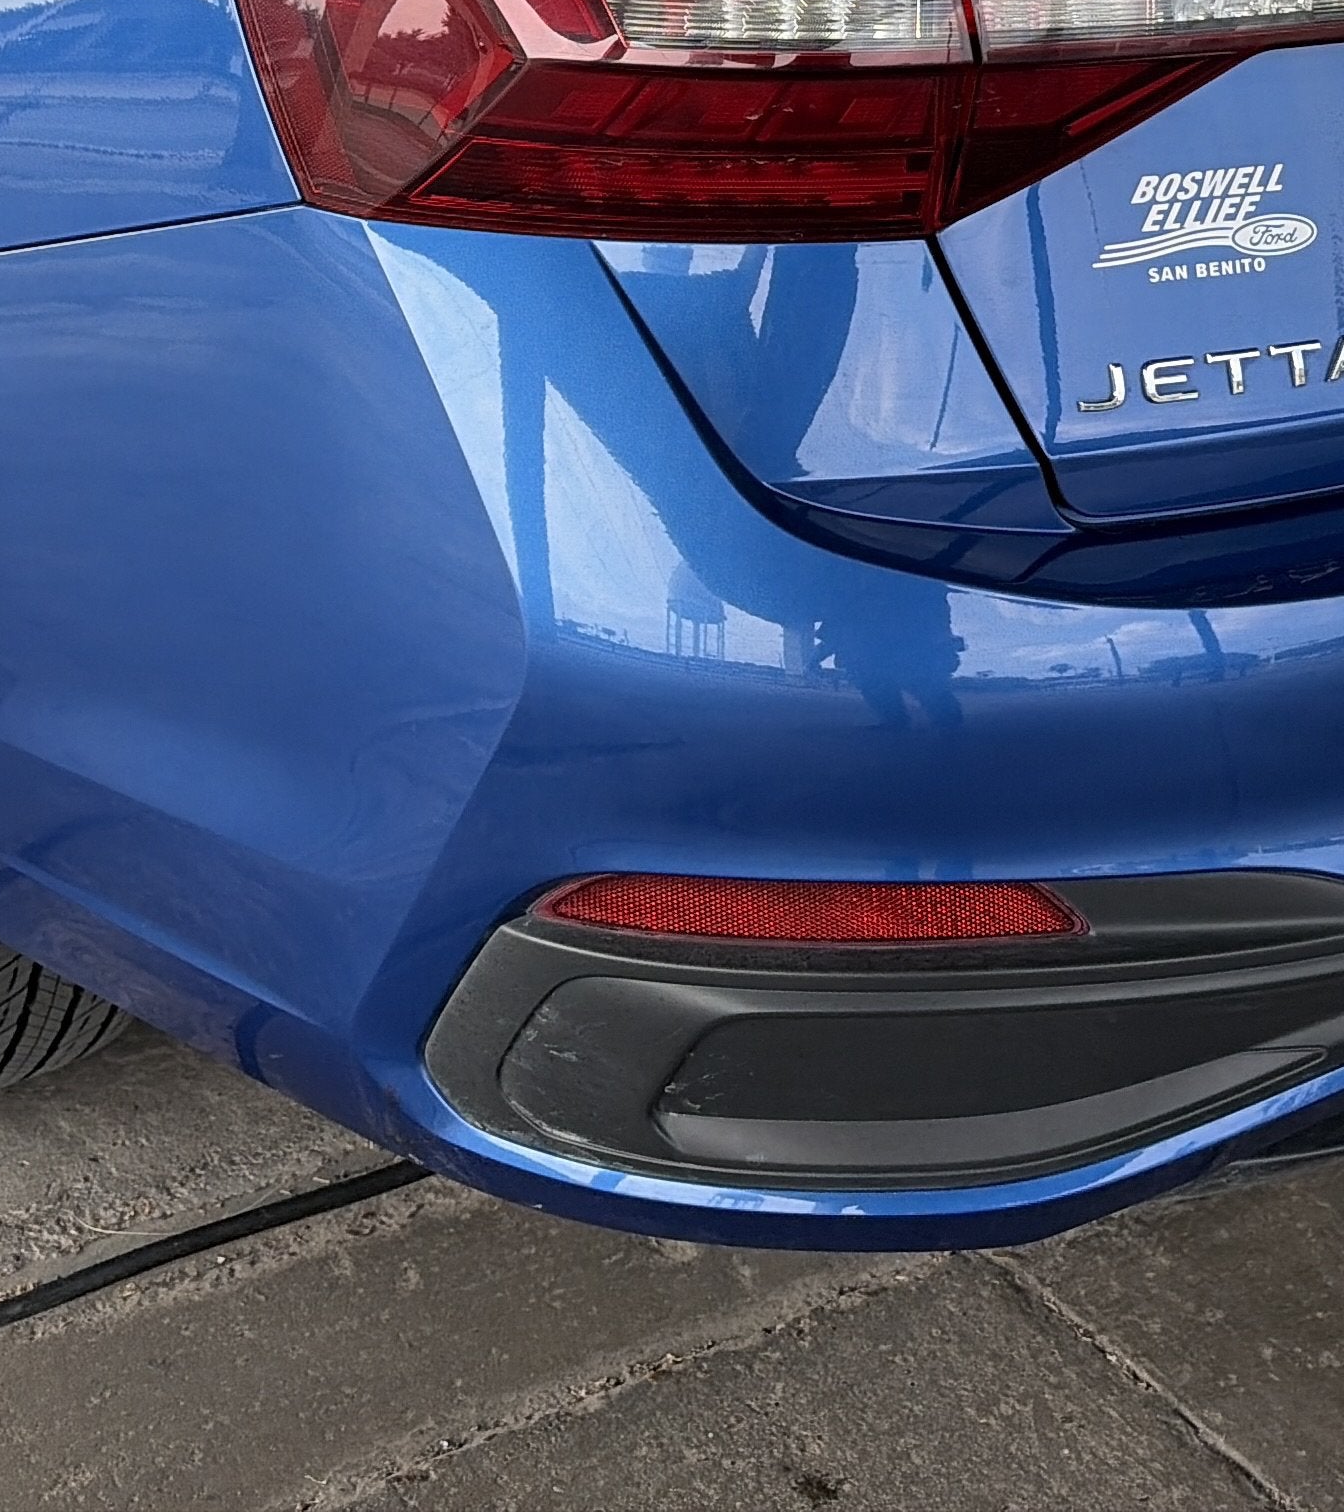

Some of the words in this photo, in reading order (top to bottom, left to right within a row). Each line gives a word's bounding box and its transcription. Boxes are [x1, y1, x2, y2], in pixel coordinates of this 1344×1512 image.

[1131, 164, 1283, 204] BOSWELL
[1141, 195, 1261, 232] ELLIFF
[1249, 223, 1298, 247] Ford
[1148, 264, 1188, 283] SAN
[1195, 257, 1266, 278] BENITO
